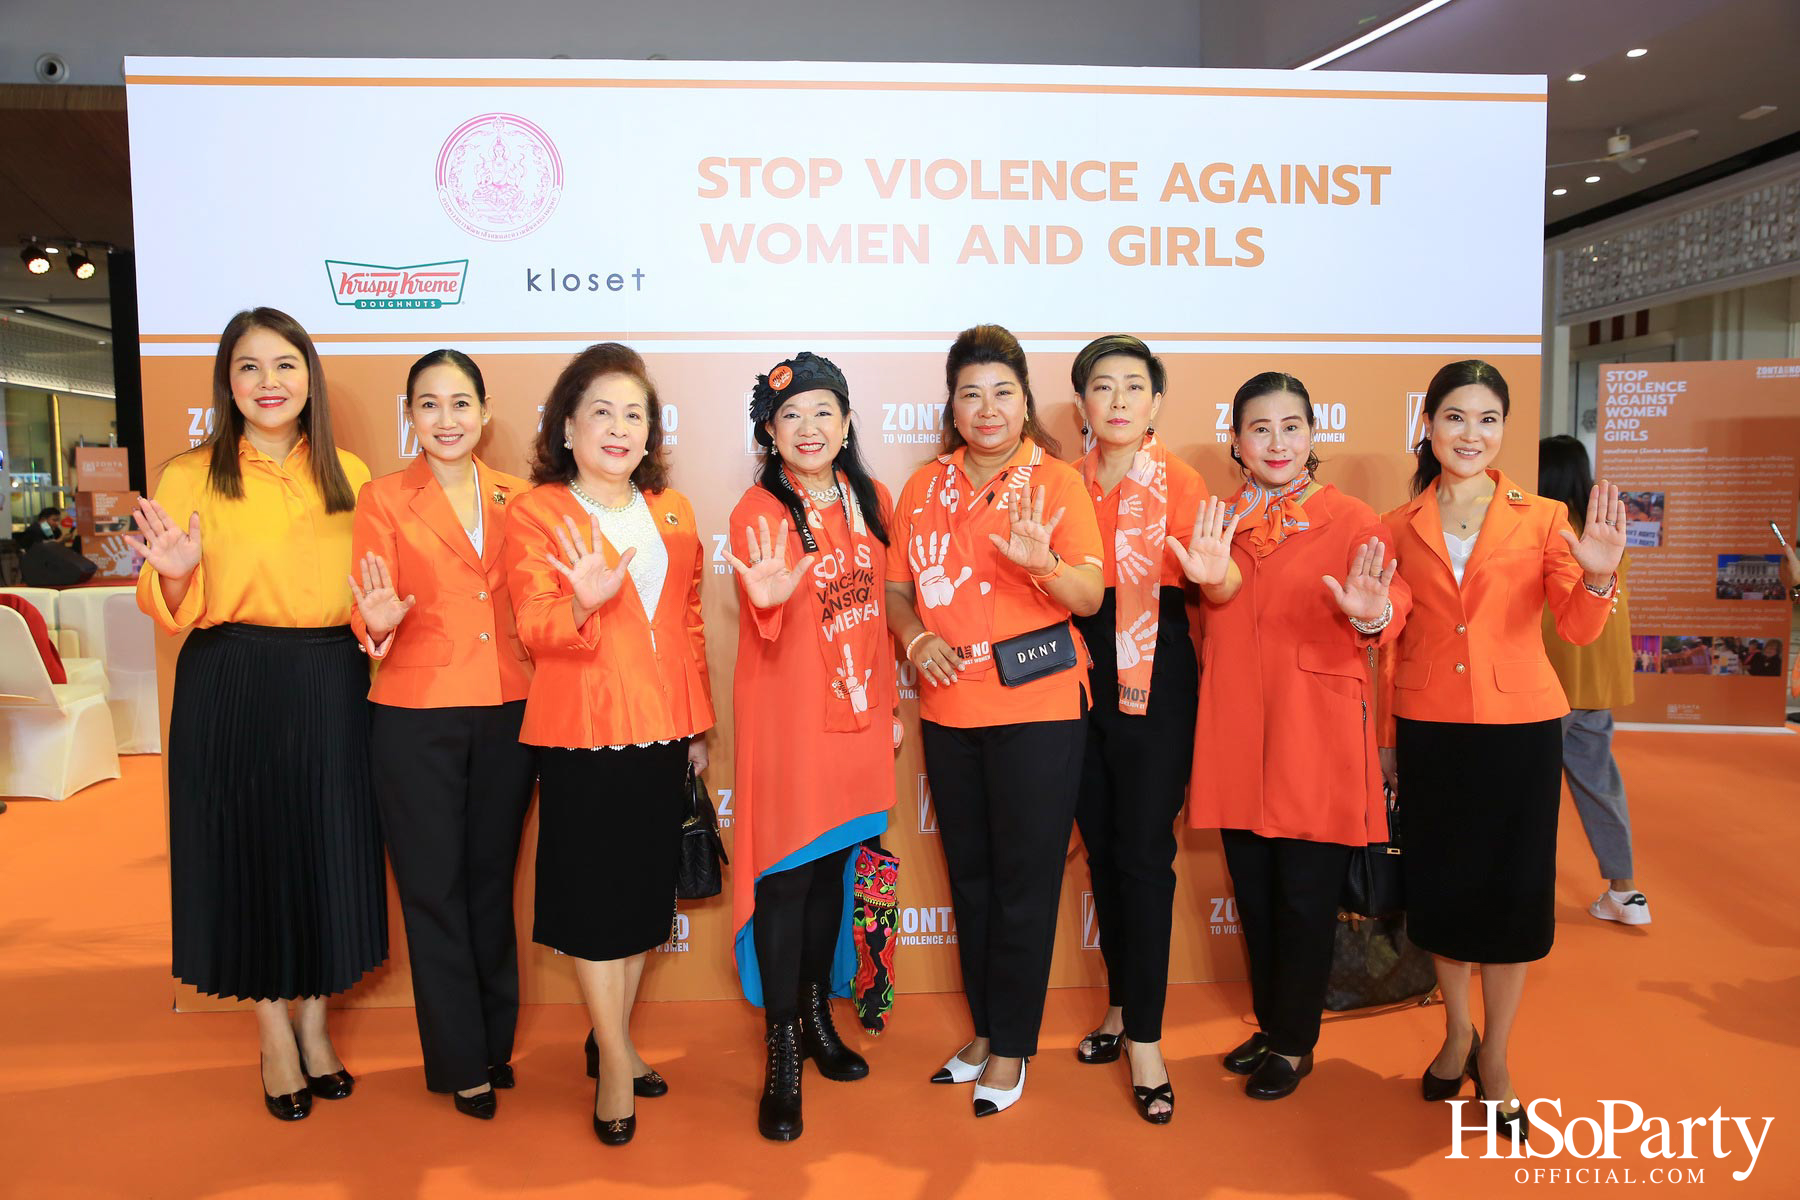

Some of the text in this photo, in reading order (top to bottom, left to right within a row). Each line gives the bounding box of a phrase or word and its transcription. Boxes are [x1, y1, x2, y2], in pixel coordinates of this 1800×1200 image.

[698, 156, 1392, 206] STOP VIOLENCE AGAINST
[700, 222, 1266, 269] WOMEN AND GIRLS
[339, 271, 461, 298] Krispy Kreme
[526, 267, 646, 292] kloset
[360, 300, 437, 308] DOUGHNUTS
[1605, 369, 1648, 382] STOP
[1606, 381, 1687, 394] VIOLENCE
[1605, 393, 1677, 406] AGAINST
[1605, 406, 1668, 418] WOMEN
[1604, 418, 1640, 430] AND
[883, 434, 941, 444] TO VIOLENCE
[1215, 433, 1227, 443] TO
[1313, 433, 1345, 443] WOMEN
[1603, 430, 1649, 442] GIRLS
[713, 565, 724, 574] TO
[972, 641, 990, 658] NO
[1017, 641, 1057, 663] DKNY
[718, 818, 731, 828] TO
[1210, 925, 1221, 935] TO
[901, 935, 944, 946] VIOLENCE
